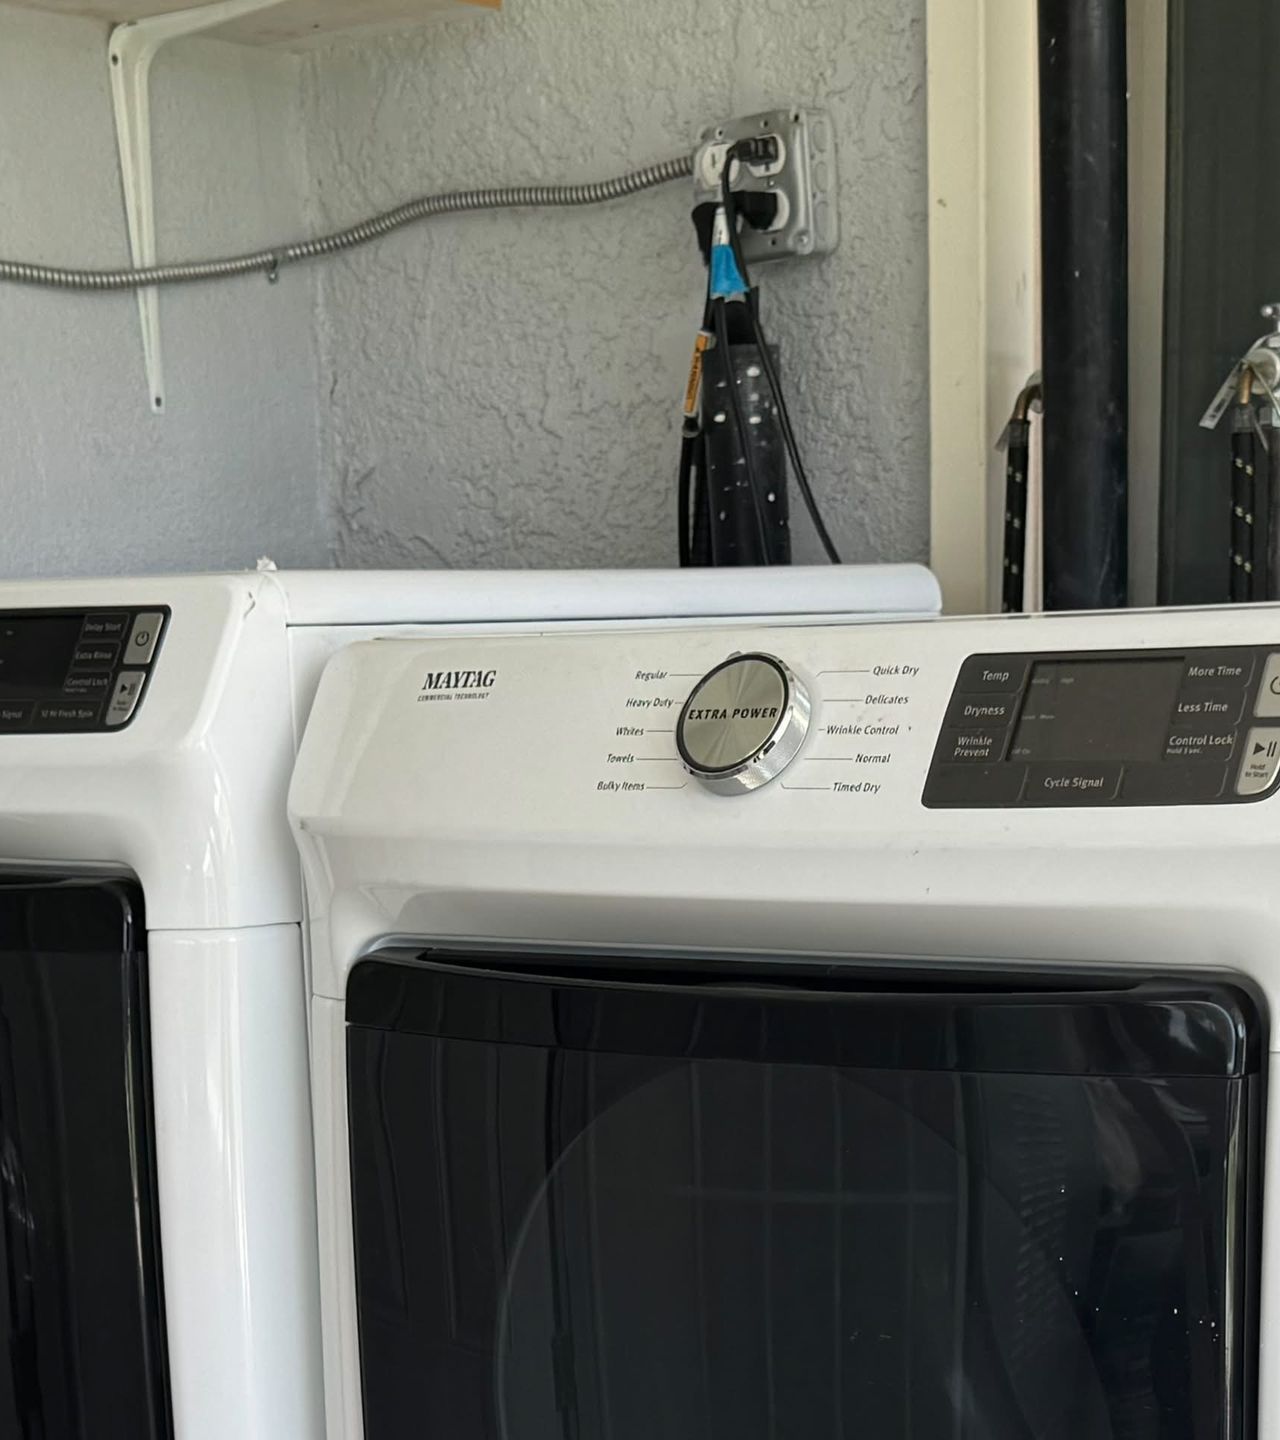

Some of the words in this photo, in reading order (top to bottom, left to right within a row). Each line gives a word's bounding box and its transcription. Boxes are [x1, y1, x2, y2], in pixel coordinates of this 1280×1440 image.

[85, 622, 102, 632] Delay
[104, 622, 121, 631] Start
[635, 670, 668, 681] Regular
[872, 665, 900, 676] Quick
[902, 665, 919, 677] Dry
[982, 670, 1009, 681] Temp
[1188, 666, 1215, 677] More
[1217, 665, 1242, 676] Time
[67, 677, 90, 687] Control
[91, 677, 108, 686] Lock
[422, 670, 496, 690] MAYTAG
[626, 698, 651, 708] Heavy
[653, 697, 674, 708] Duty
[865, 694, 909, 704] Delicates
[964, 705, 1005, 717] Dryness
[1177, 702, 1200, 713] Less
[1204, 701, 1228, 712] Time
[58, 709, 77, 718] Fresh
[78, 710, 93, 719] Spin
[688, 709, 727, 720] EXTRA
[731, 707, 778, 719] POWER
[615, 727, 644, 736] Whites
[826, 725, 862, 735] Wrinkle
[864, 725, 899, 735] Control
[958, 736, 992, 746] Wrinkle
[1169, 735, 1206, 746] Control
[1208, 734, 1233, 745] Lock
[954, 747, 989, 757] Prevent
[606, 753, 634, 763] Towels
[855, 753, 891, 763] Normal
[597, 781, 620, 791] Bulky
[621, 782, 645, 791] Items
[833, 782, 862, 792] Timed
[863, 783, 881, 794] Dry
[1044, 777, 1070, 788] Cycle
[1072, 777, 1104, 789] Signal
